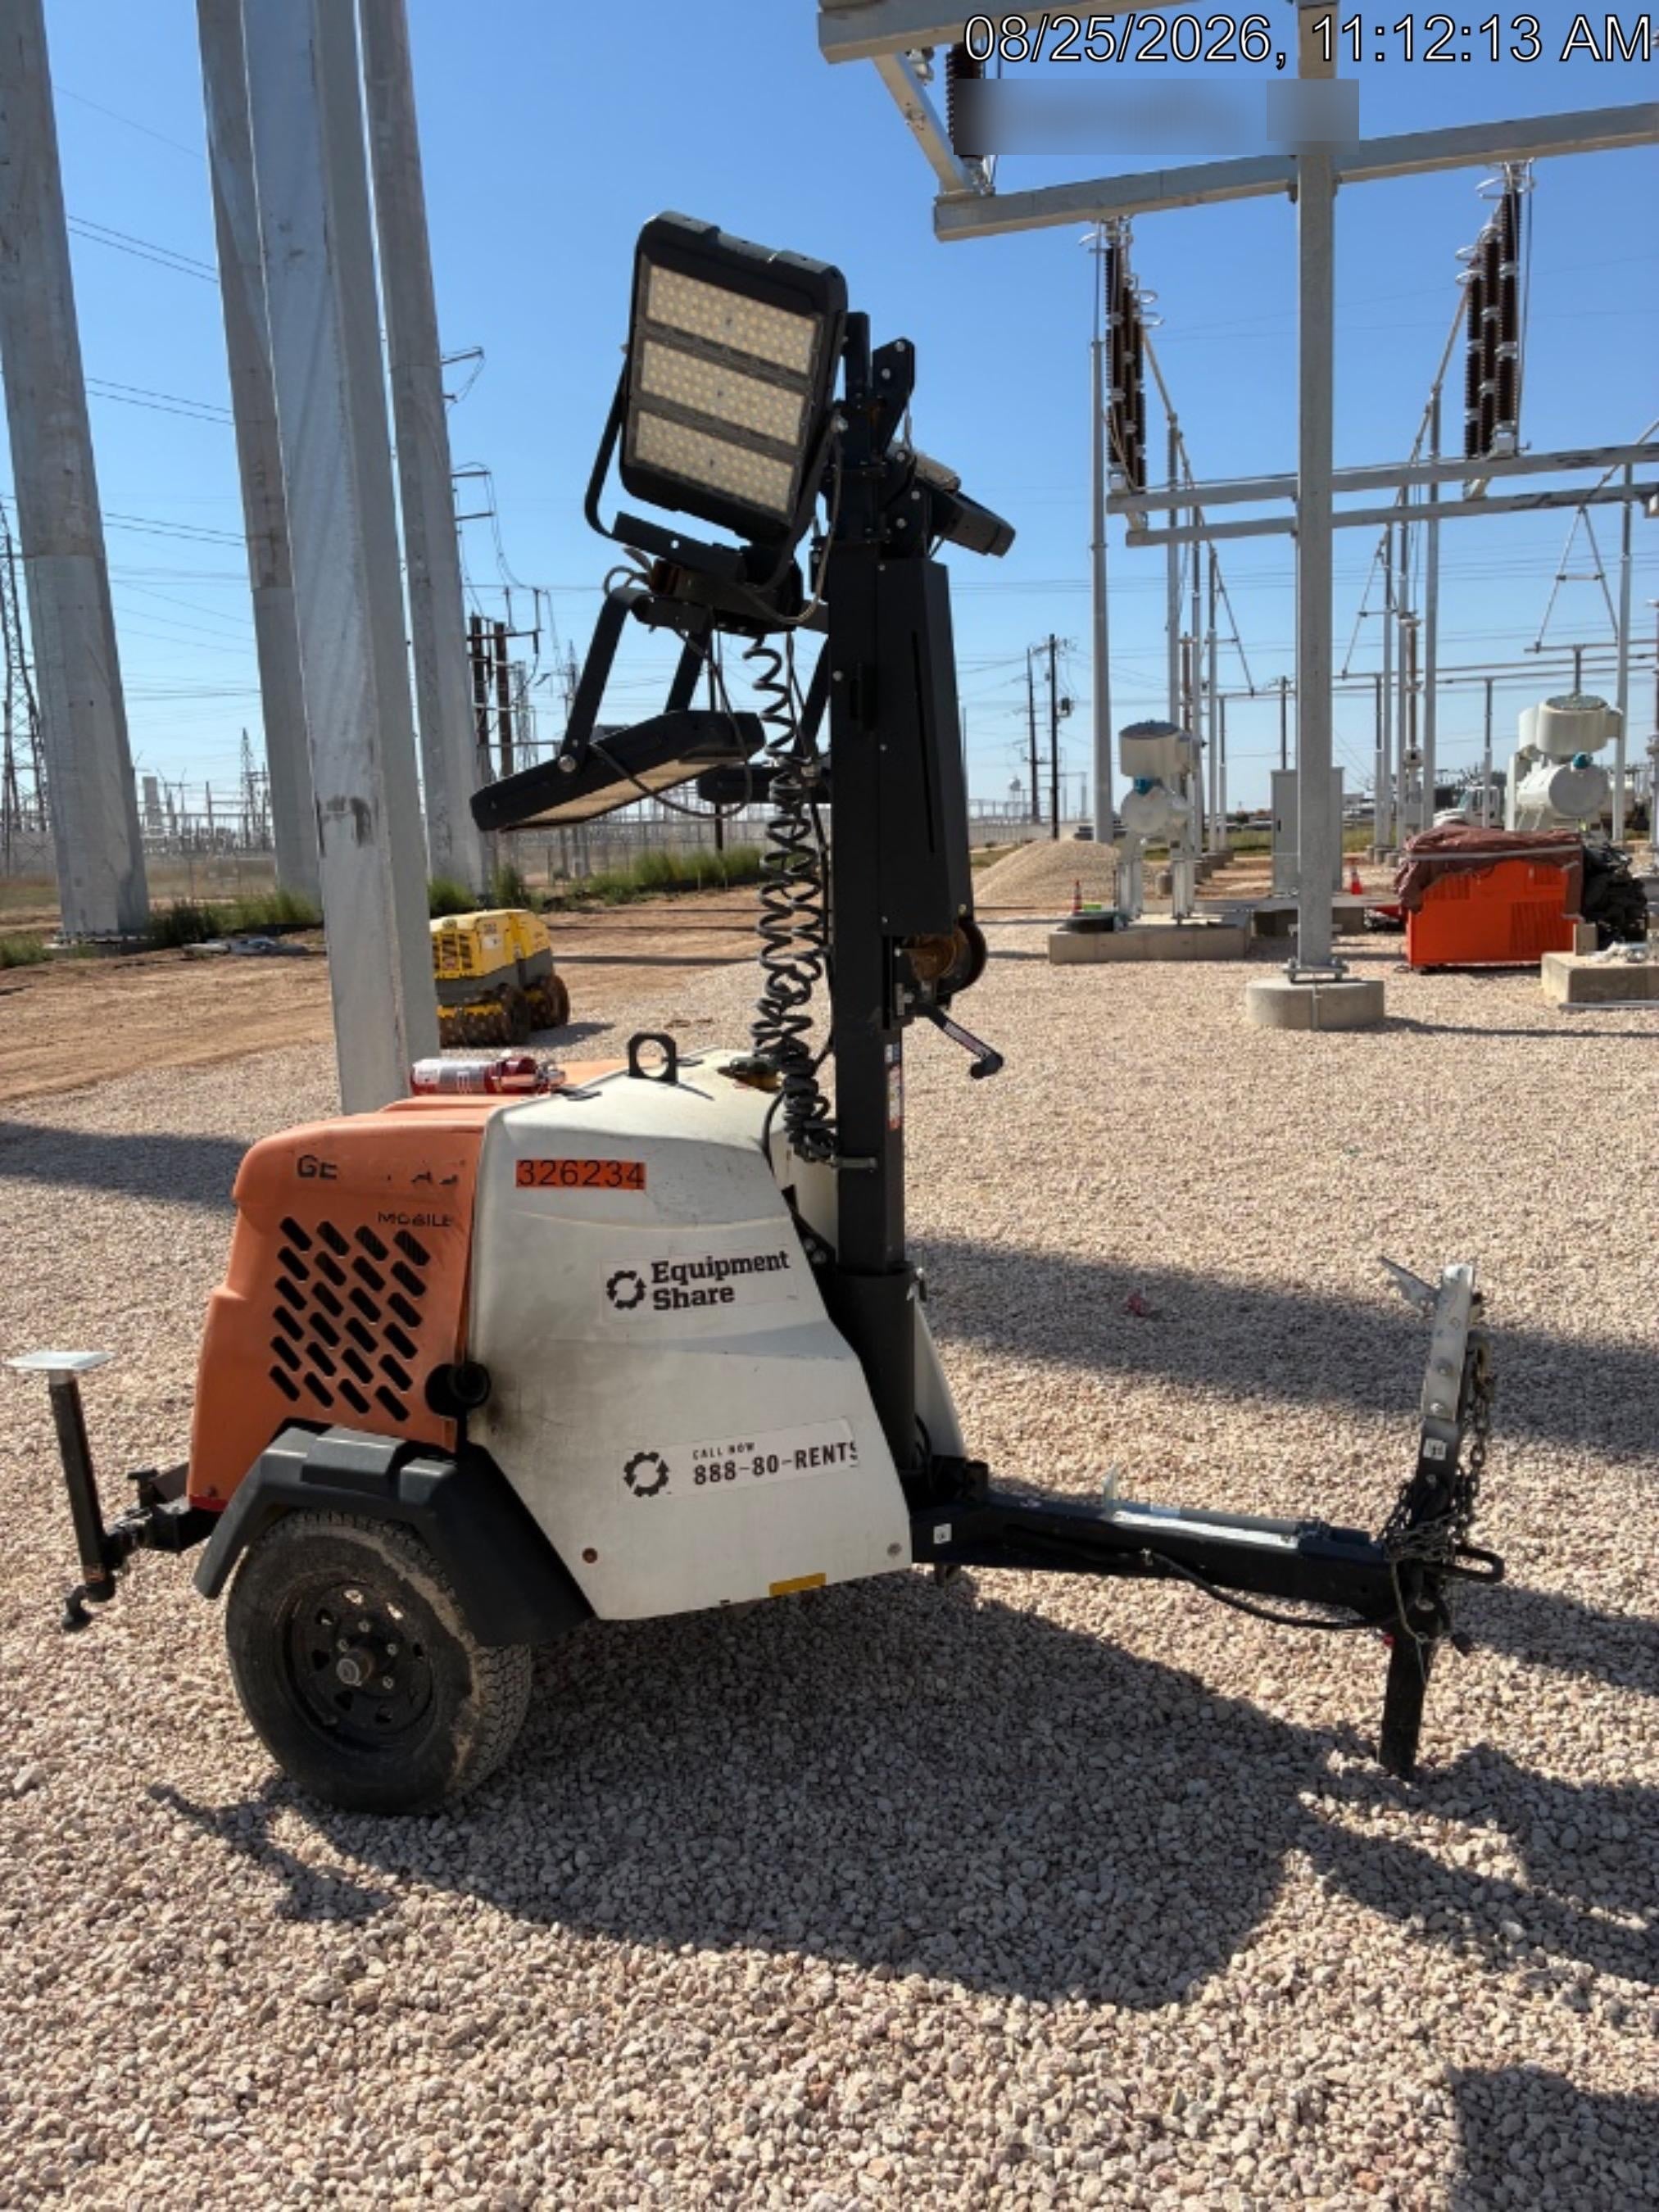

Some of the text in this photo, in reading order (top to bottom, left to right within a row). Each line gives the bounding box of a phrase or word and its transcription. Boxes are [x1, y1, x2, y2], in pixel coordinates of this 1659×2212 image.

[517, 1159, 645, 1188] 326234
[651, 1250, 791, 1285] Equipment
[653, 1286, 735, 1311] Share
[693, 1442, 755, 1460] CALL NOW
